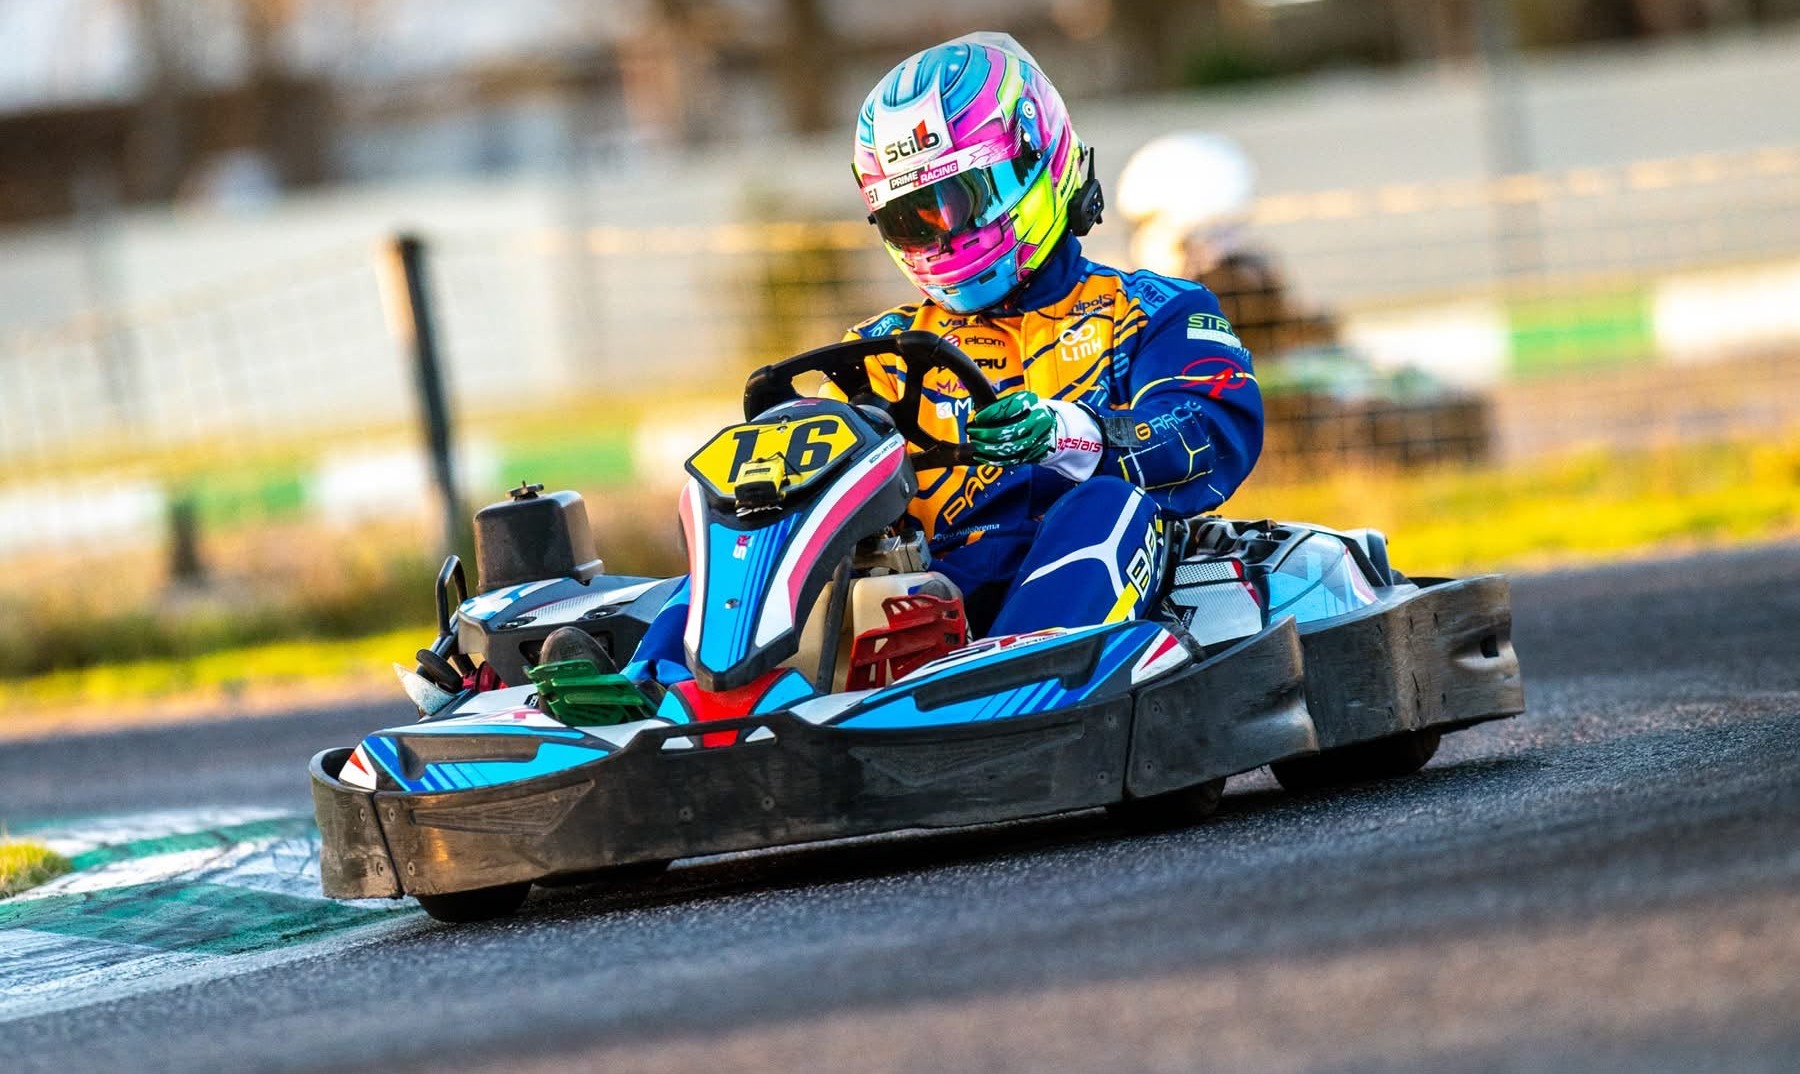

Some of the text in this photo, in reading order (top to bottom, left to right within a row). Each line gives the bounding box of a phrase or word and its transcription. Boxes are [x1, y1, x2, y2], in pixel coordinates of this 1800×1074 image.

[891, 171, 918, 189] PRIME
[920, 162, 957, 183] RACING
[727, 419, 839, 483] 16
